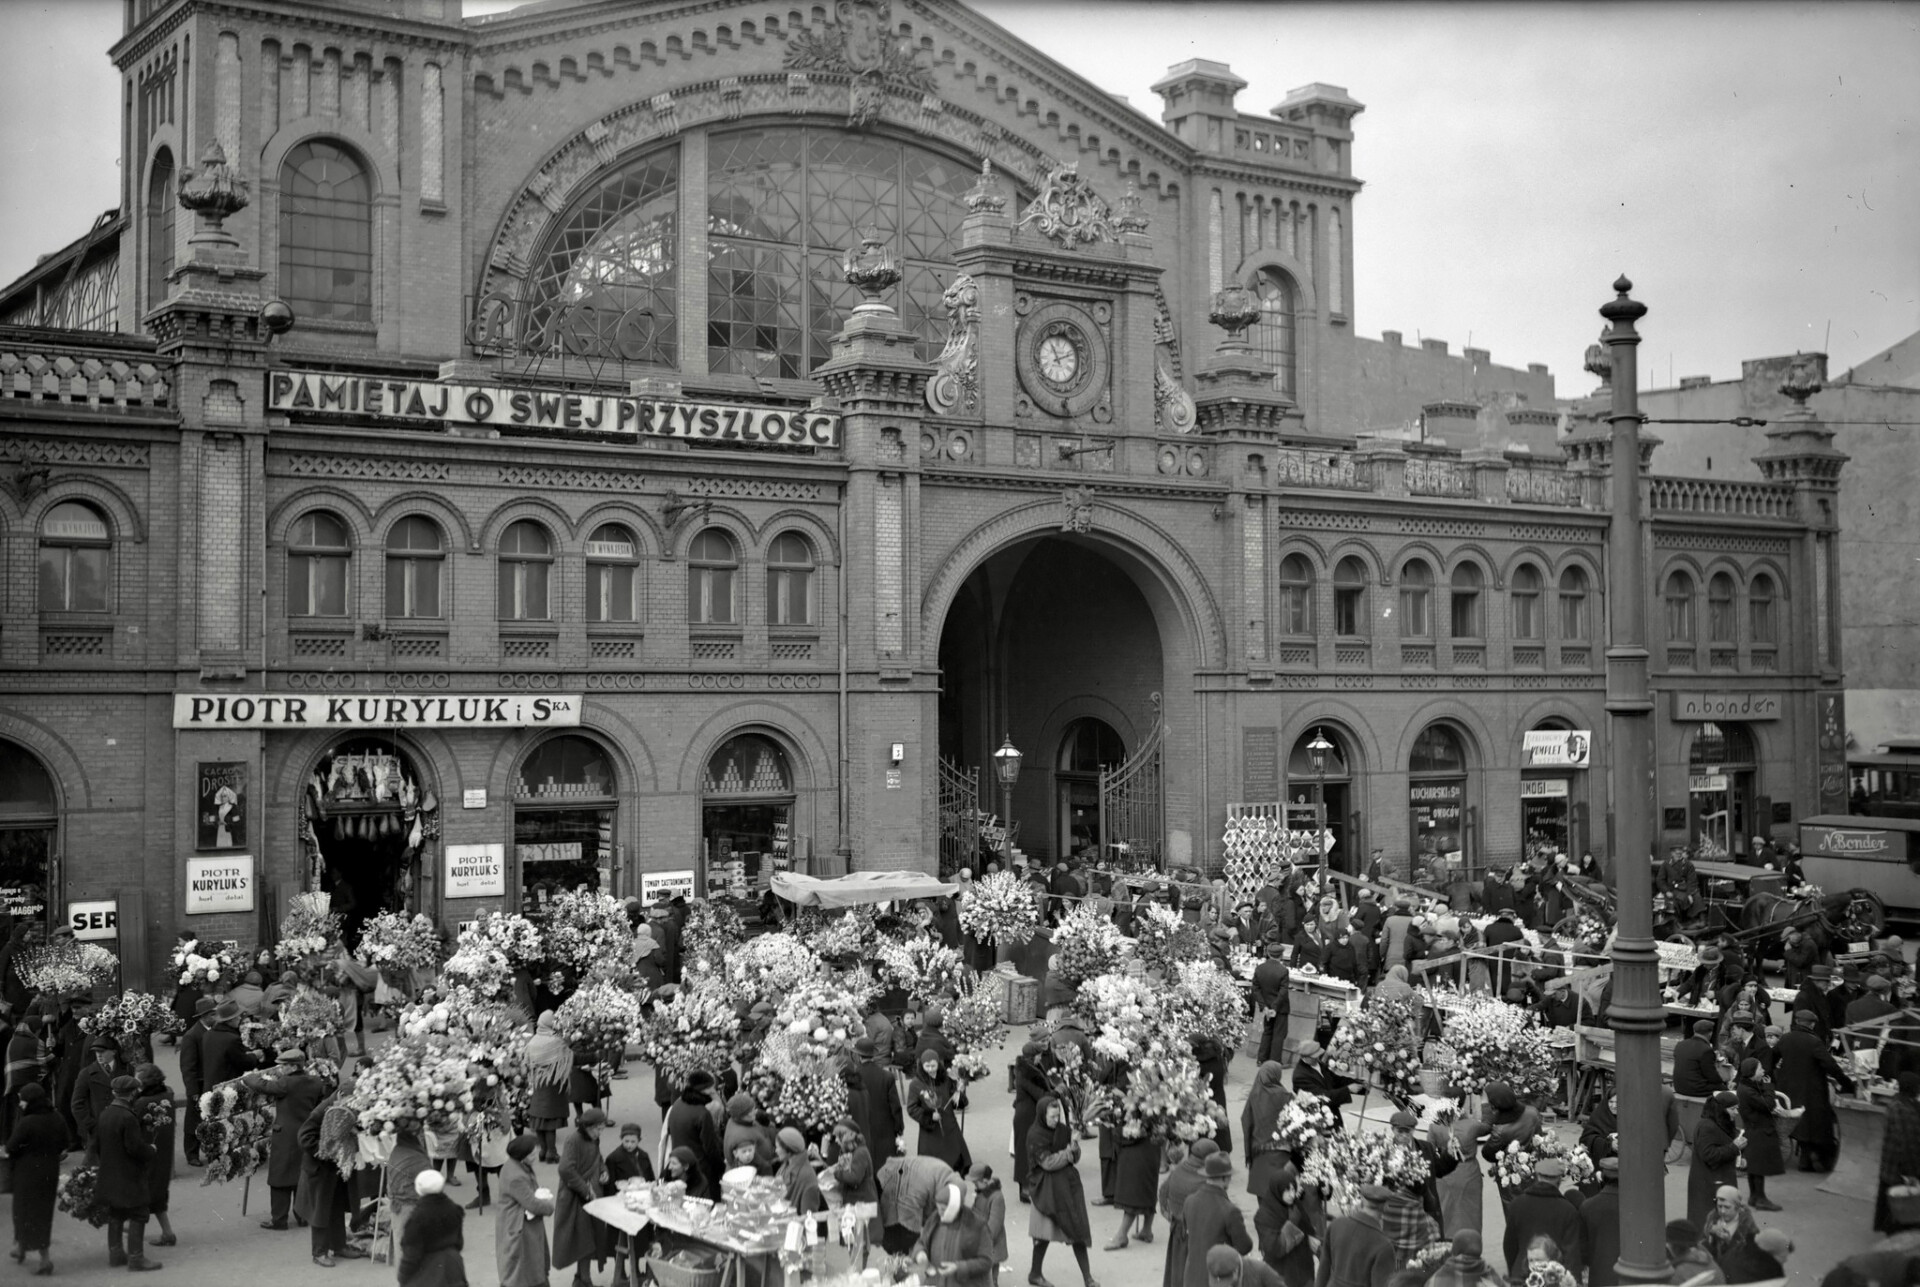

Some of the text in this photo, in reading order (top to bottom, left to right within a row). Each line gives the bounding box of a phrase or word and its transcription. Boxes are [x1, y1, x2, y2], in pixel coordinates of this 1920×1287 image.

[465, 390, 494, 421] O
[510, 393, 604, 428] SWEJ
[189, 697, 308, 722] PIOTR
[325, 698, 509, 723] KURYLUK
[515, 704, 522, 722] i
[458, 855, 493, 865] PIOTR
[201, 868, 241, 878] PIOTR
[451, 865, 491, 878] KURYLUK
[192, 878, 238, 892] KURYLUK
[72, 911, 117, 931] SER
